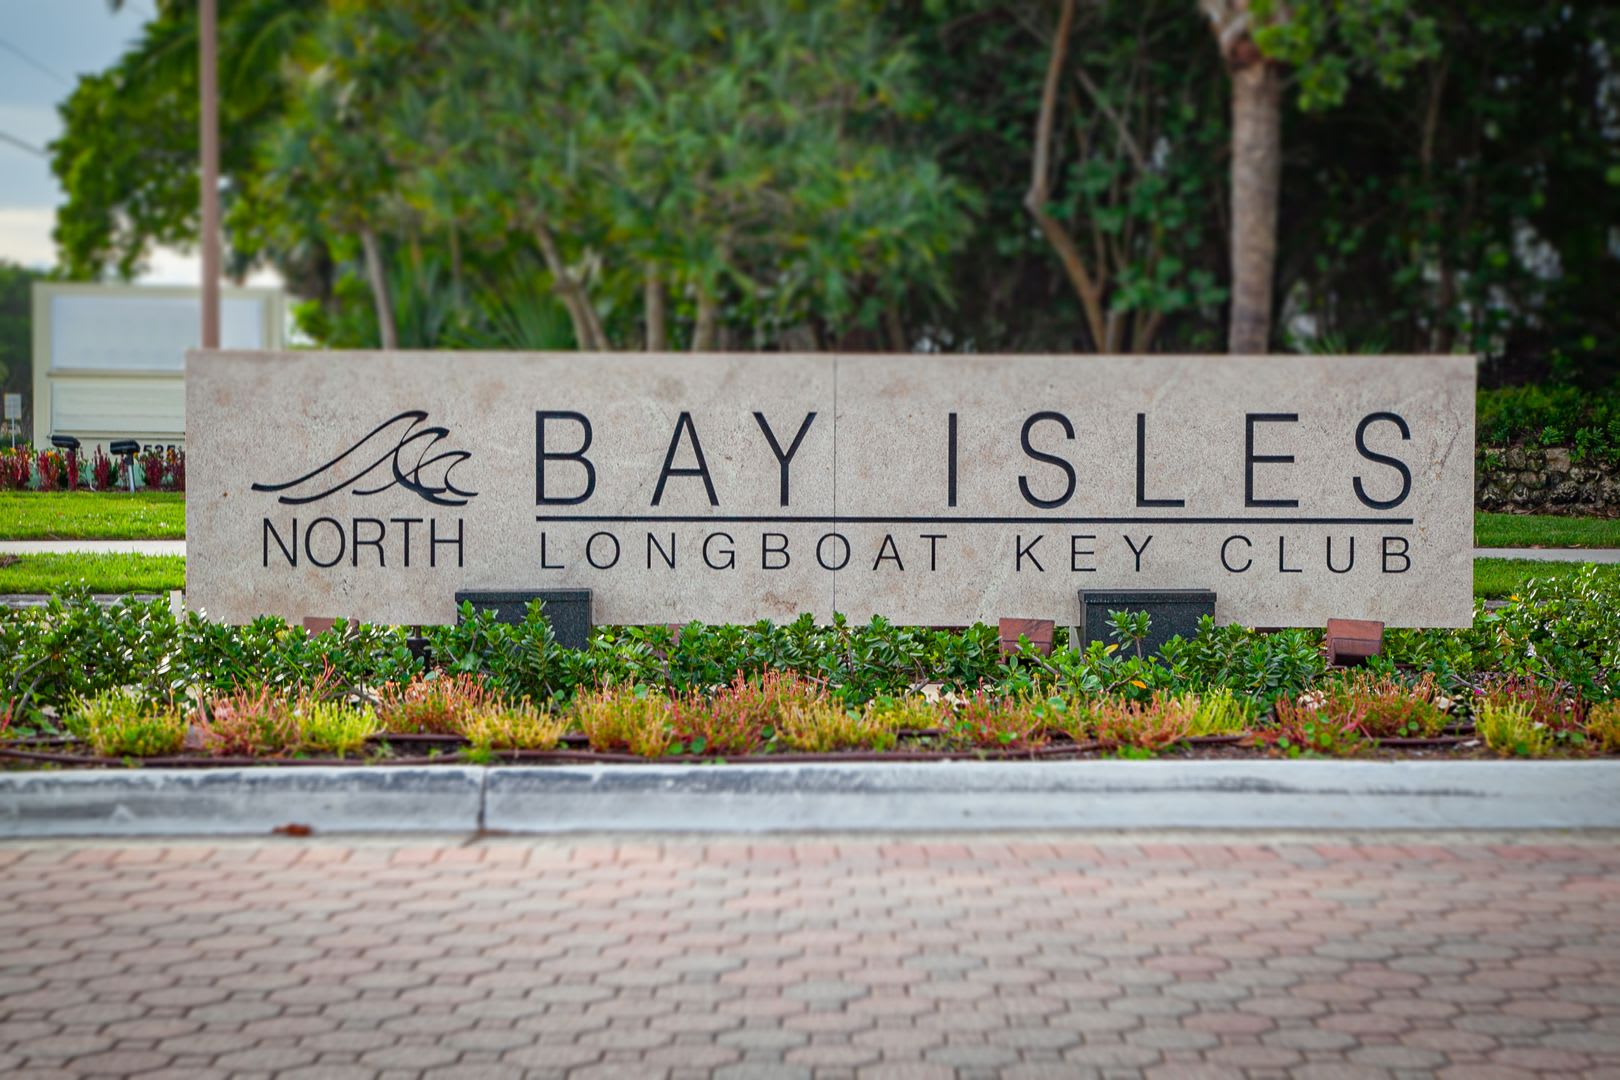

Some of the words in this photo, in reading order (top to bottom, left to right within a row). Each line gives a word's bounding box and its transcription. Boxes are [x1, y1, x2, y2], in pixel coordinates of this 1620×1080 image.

[535, 410, 818, 508] BAY
[947, 410, 1412, 511] ISLES
[263, 516, 464, 569] NORTH
[540, 531, 948, 572] LONGBOAT
[1016, 534, 1154, 573] KEY
[1220, 534, 1411, 574] CLUB
